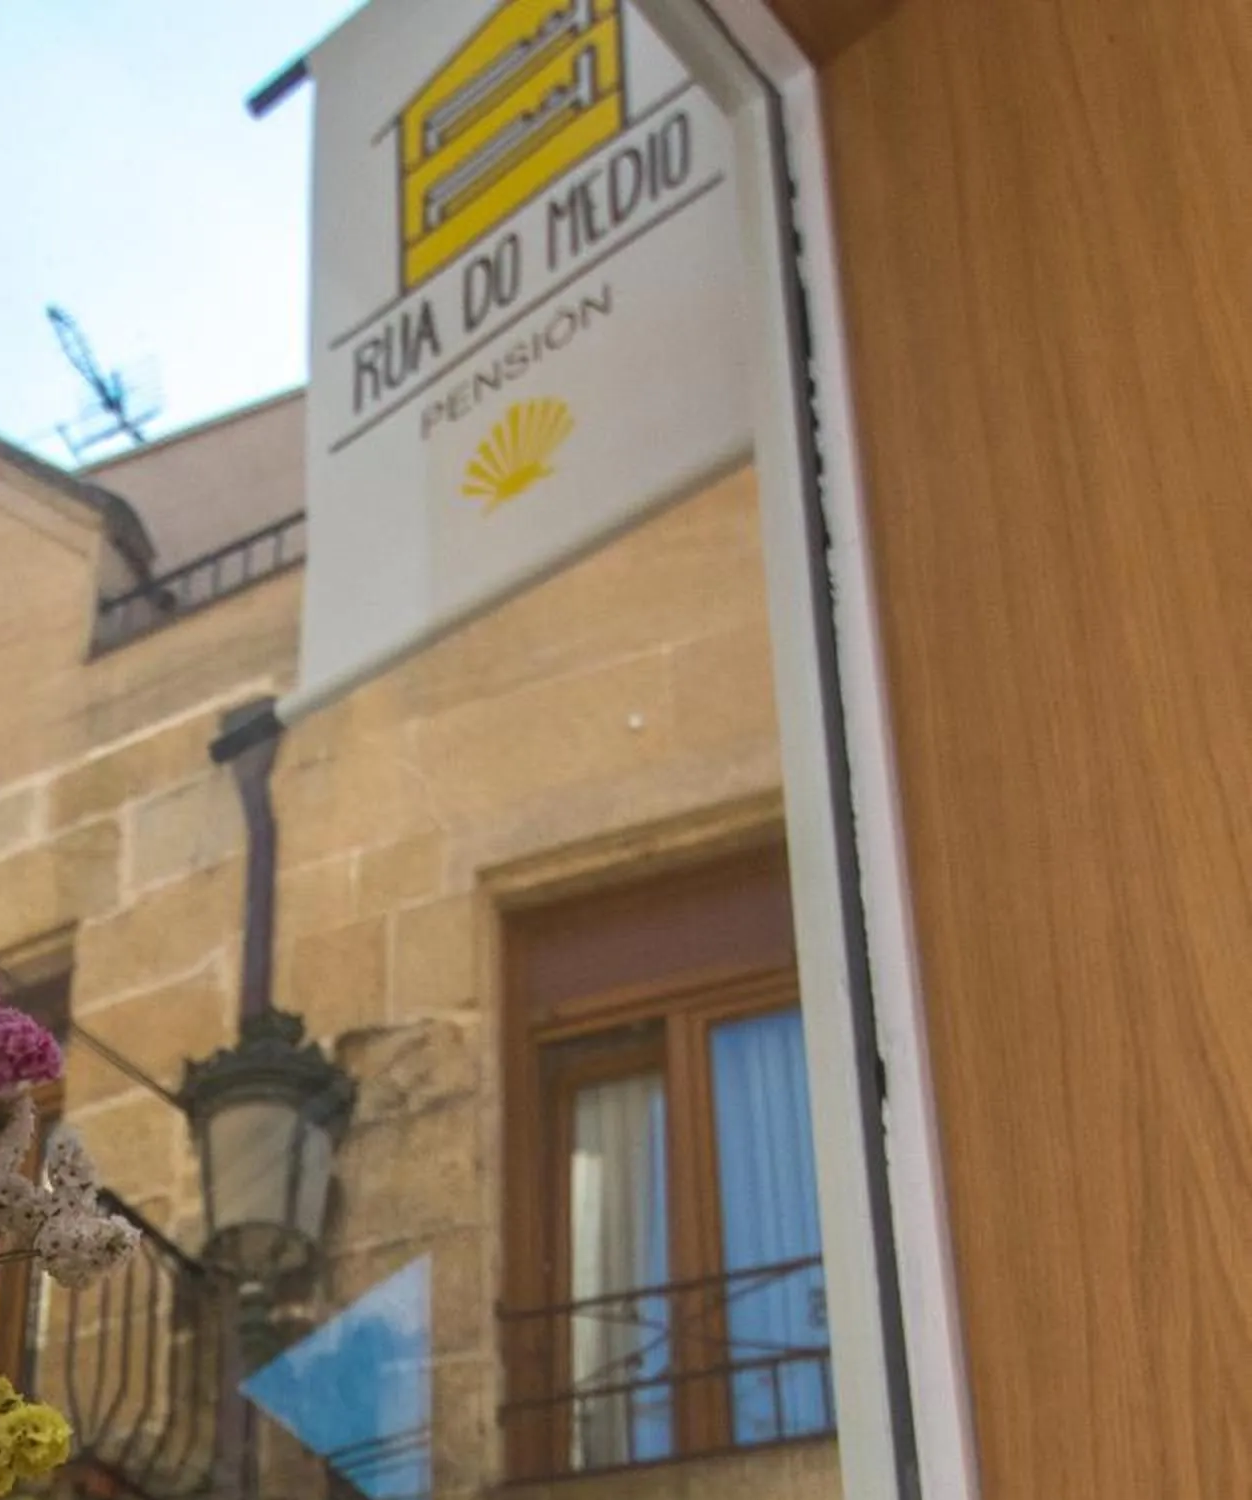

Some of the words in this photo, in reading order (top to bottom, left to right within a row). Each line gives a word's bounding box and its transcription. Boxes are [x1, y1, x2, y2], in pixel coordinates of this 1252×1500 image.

[352, 301, 442, 416] RUA
[462, 231, 521, 334] DO
[546, 110, 691, 273] MEDIO
